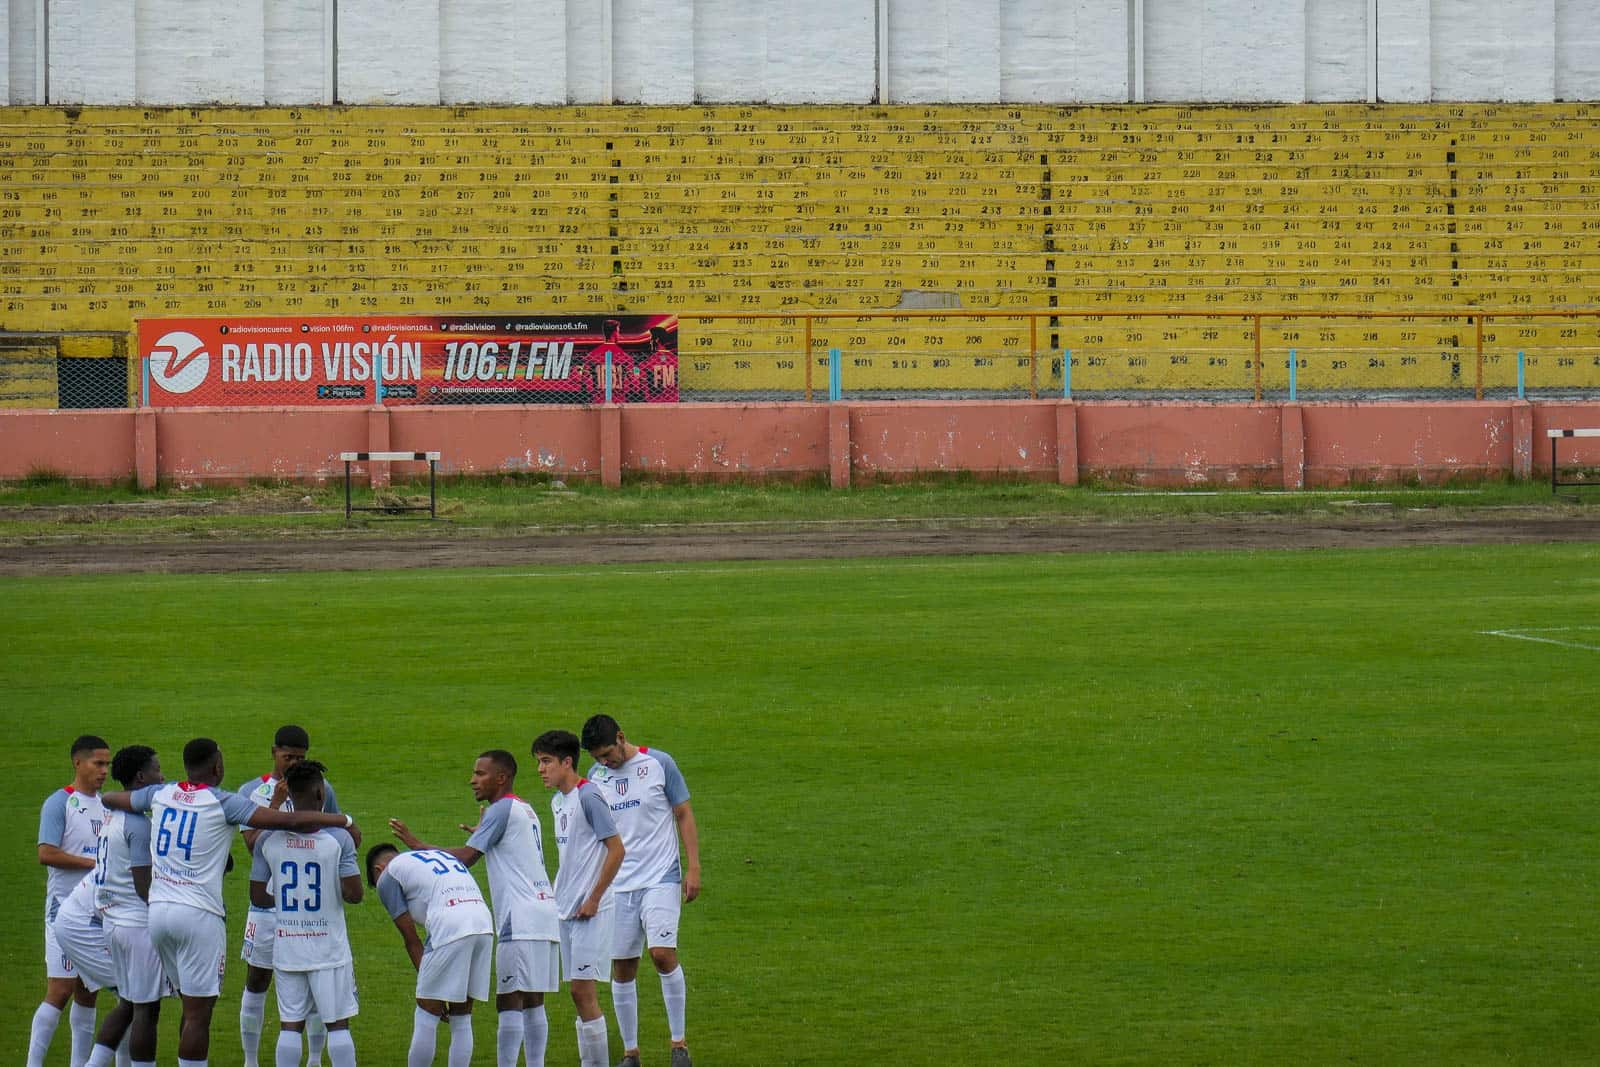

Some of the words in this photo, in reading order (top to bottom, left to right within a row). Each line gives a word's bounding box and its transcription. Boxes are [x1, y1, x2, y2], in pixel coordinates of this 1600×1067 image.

[229, 325, 294, 334] radiovisioncuenca
[309, 325, 331, 333] vision
[332, 324, 355, 333] 106fm
[449, 323, 496, 332] @radialvision
[222, 342, 313, 383] RADIO
[322, 334, 422, 383] VISIÓN
[443, 341, 521, 382] 106.1
[525, 341, 575, 382] FM
[653, 365, 676, 388] FM
[156, 806, 199, 861] 64
[280, 860, 322, 913] 23
